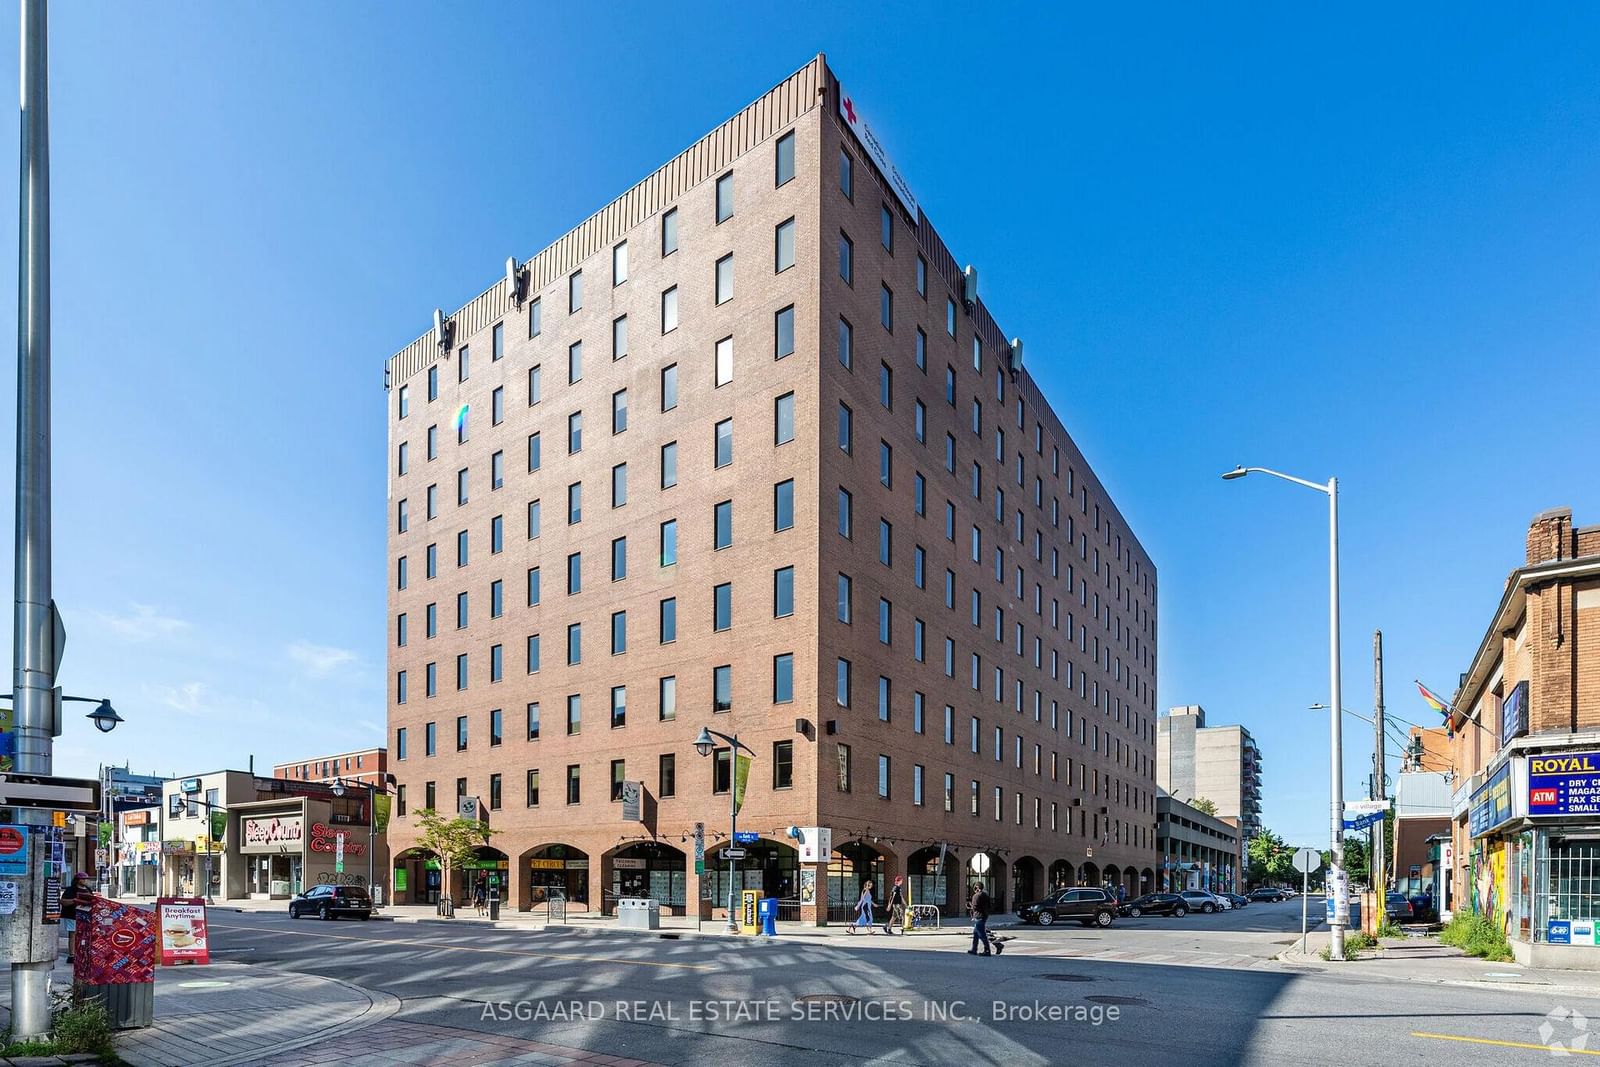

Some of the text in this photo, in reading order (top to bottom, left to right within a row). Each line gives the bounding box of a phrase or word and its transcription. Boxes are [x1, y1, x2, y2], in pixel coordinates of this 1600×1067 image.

[1532, 757, 1595, 773] ROYAL
[1568, 779, 1587, 787] DRY
[1533, 791, 1555, 802] ATM
[1568, 796, 1586, 804] FAX
[1568, 804, 1599, 812] SMALL
[246, 819, 271, 845] Sleep
[311, 822, 352, 840] Slep
